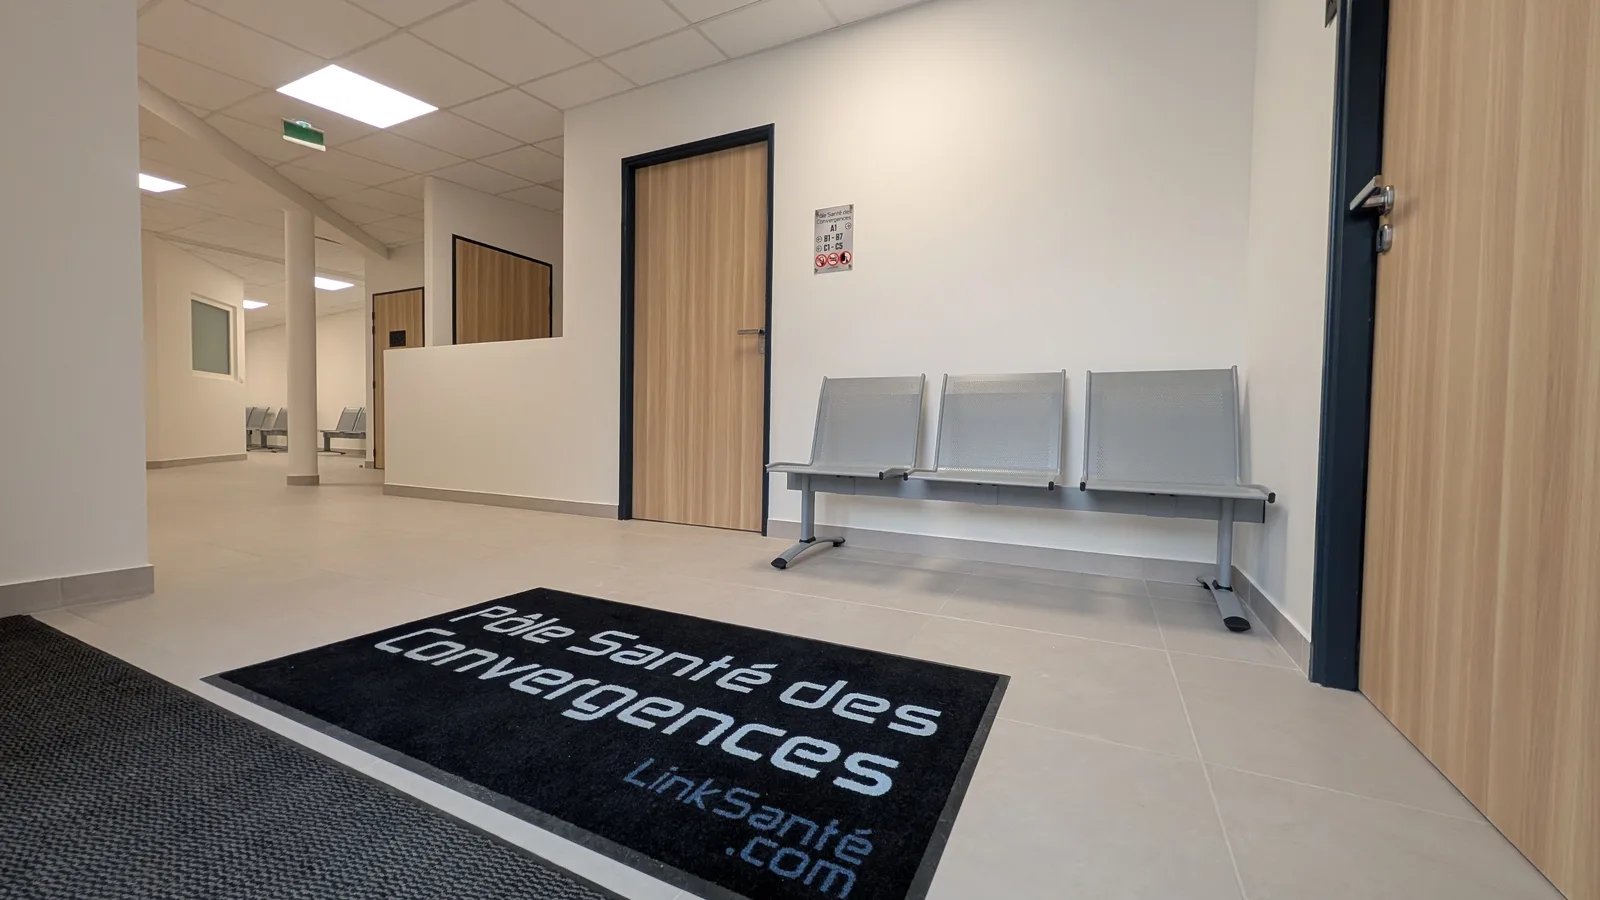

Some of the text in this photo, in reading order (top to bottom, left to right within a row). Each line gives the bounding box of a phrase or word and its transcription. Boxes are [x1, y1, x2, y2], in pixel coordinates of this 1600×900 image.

[816, 216, 851, 224] Convergences
[824, 244, 830, 252] C1
[835, 242, 843, 250] C5
[830, 224, 837, 232] A1
[449, 605, 942, 736] Pôle Santé des
[374, 627, 900, 796] Convergences
[623, 758, 873, 865] LinkSanté
[726, 836, 857, 900] .com
